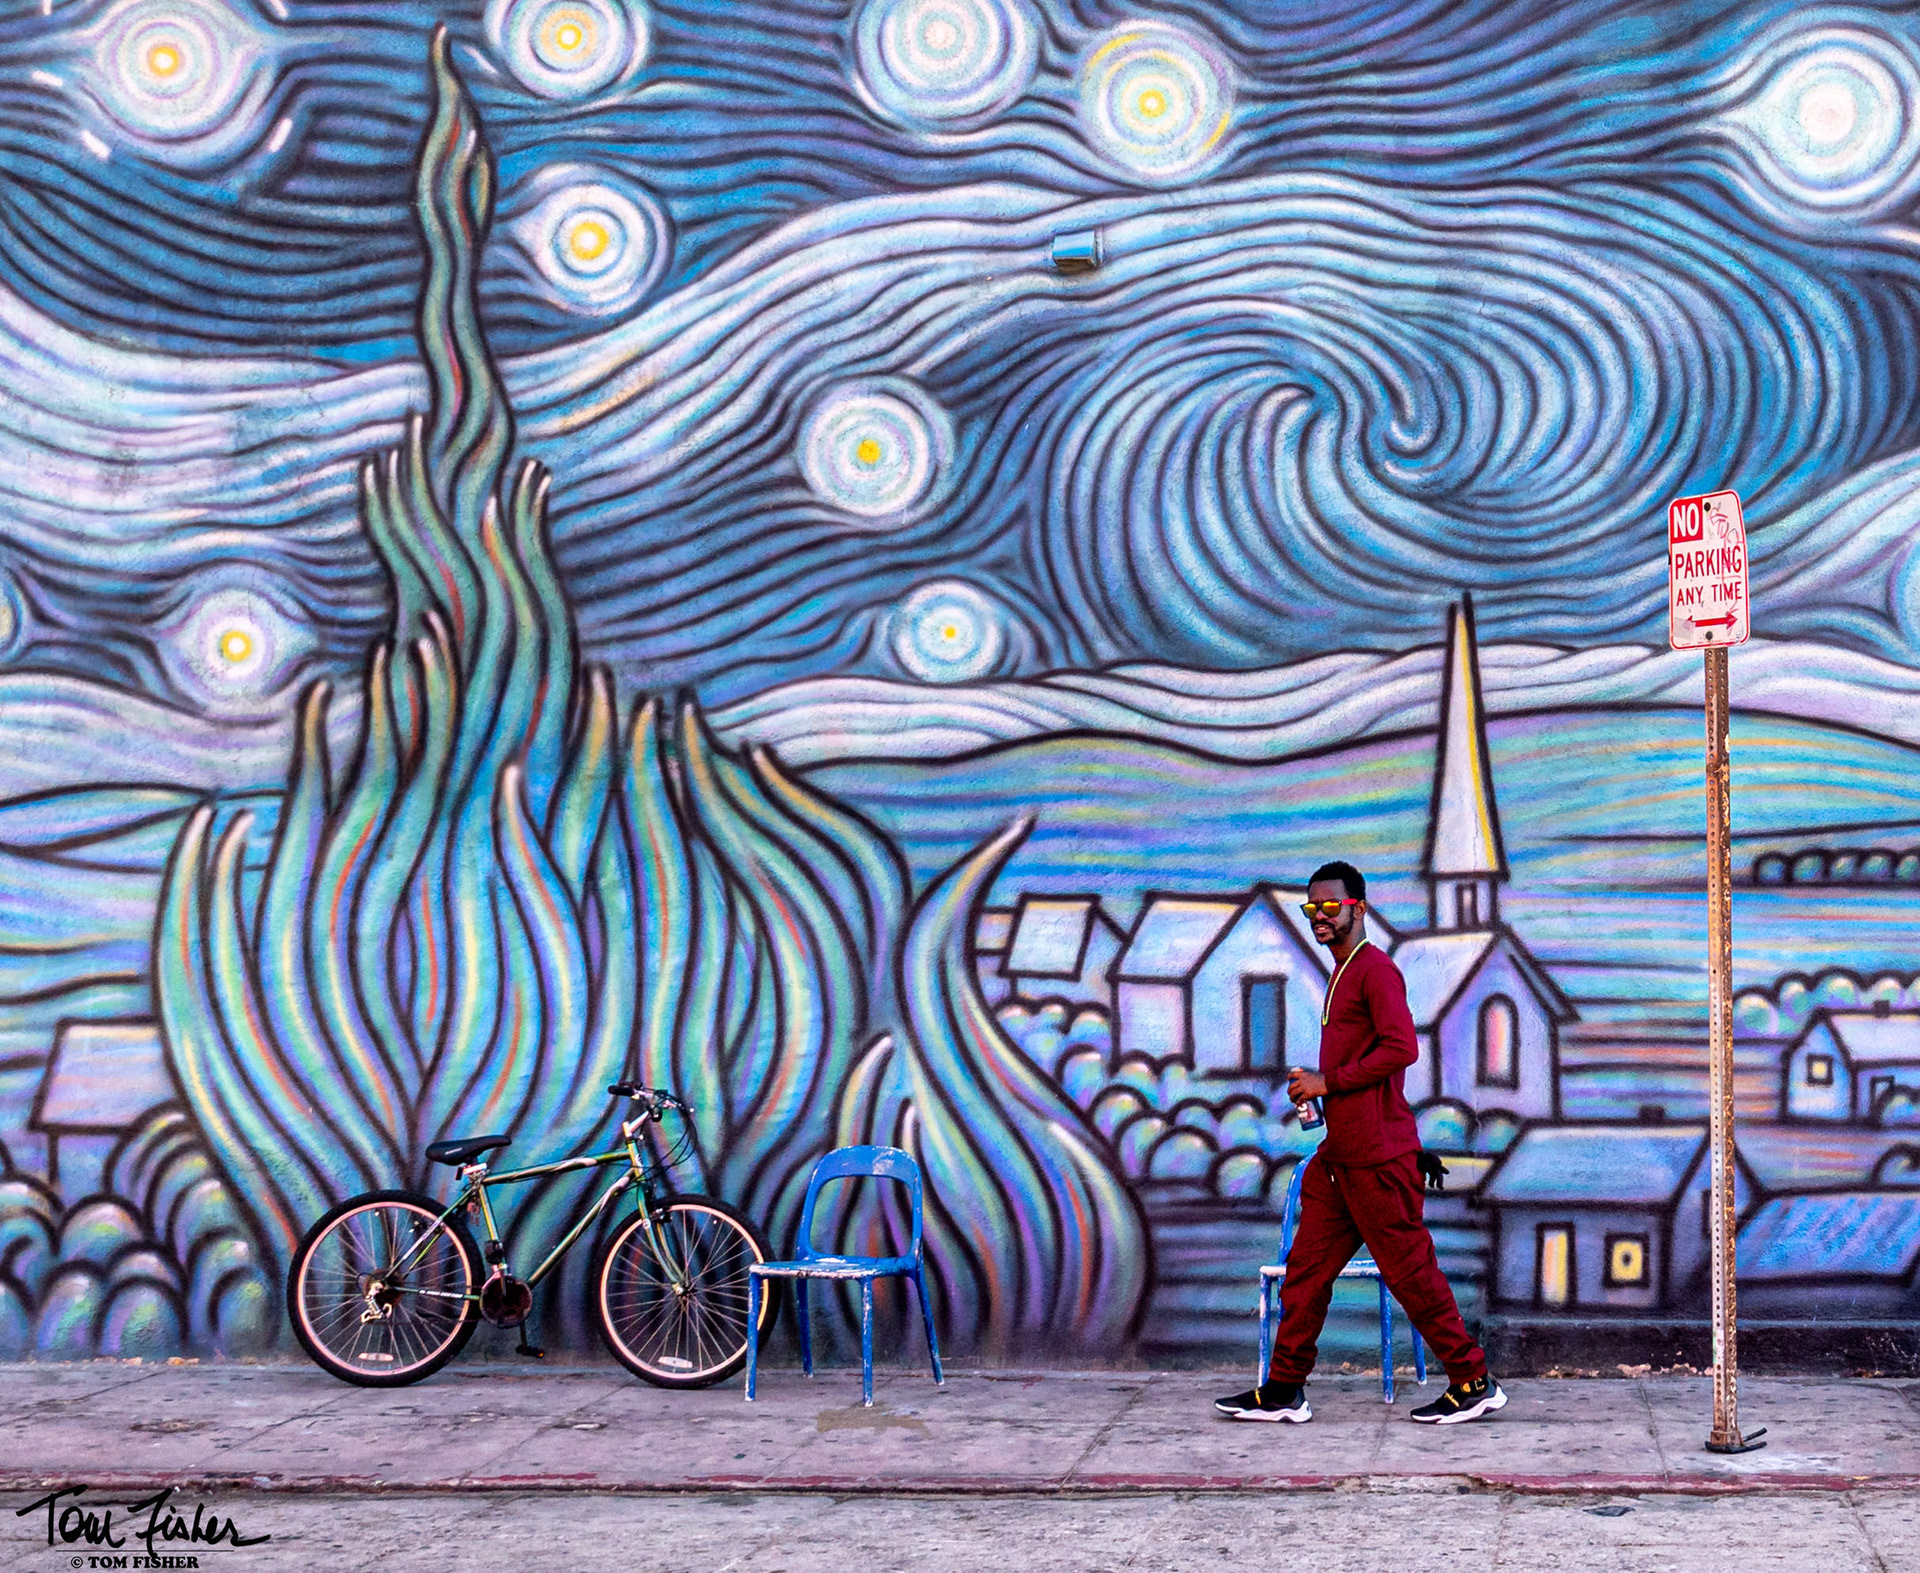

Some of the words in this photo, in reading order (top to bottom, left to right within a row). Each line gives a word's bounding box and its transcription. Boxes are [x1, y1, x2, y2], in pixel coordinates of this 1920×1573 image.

[1673, 503, 1700, 538] NO
[1675, 545, 1742, 579] PARKING
[1676, 586, 1703, 606] ANY
[1711, 582, 1742, 602] TIME
